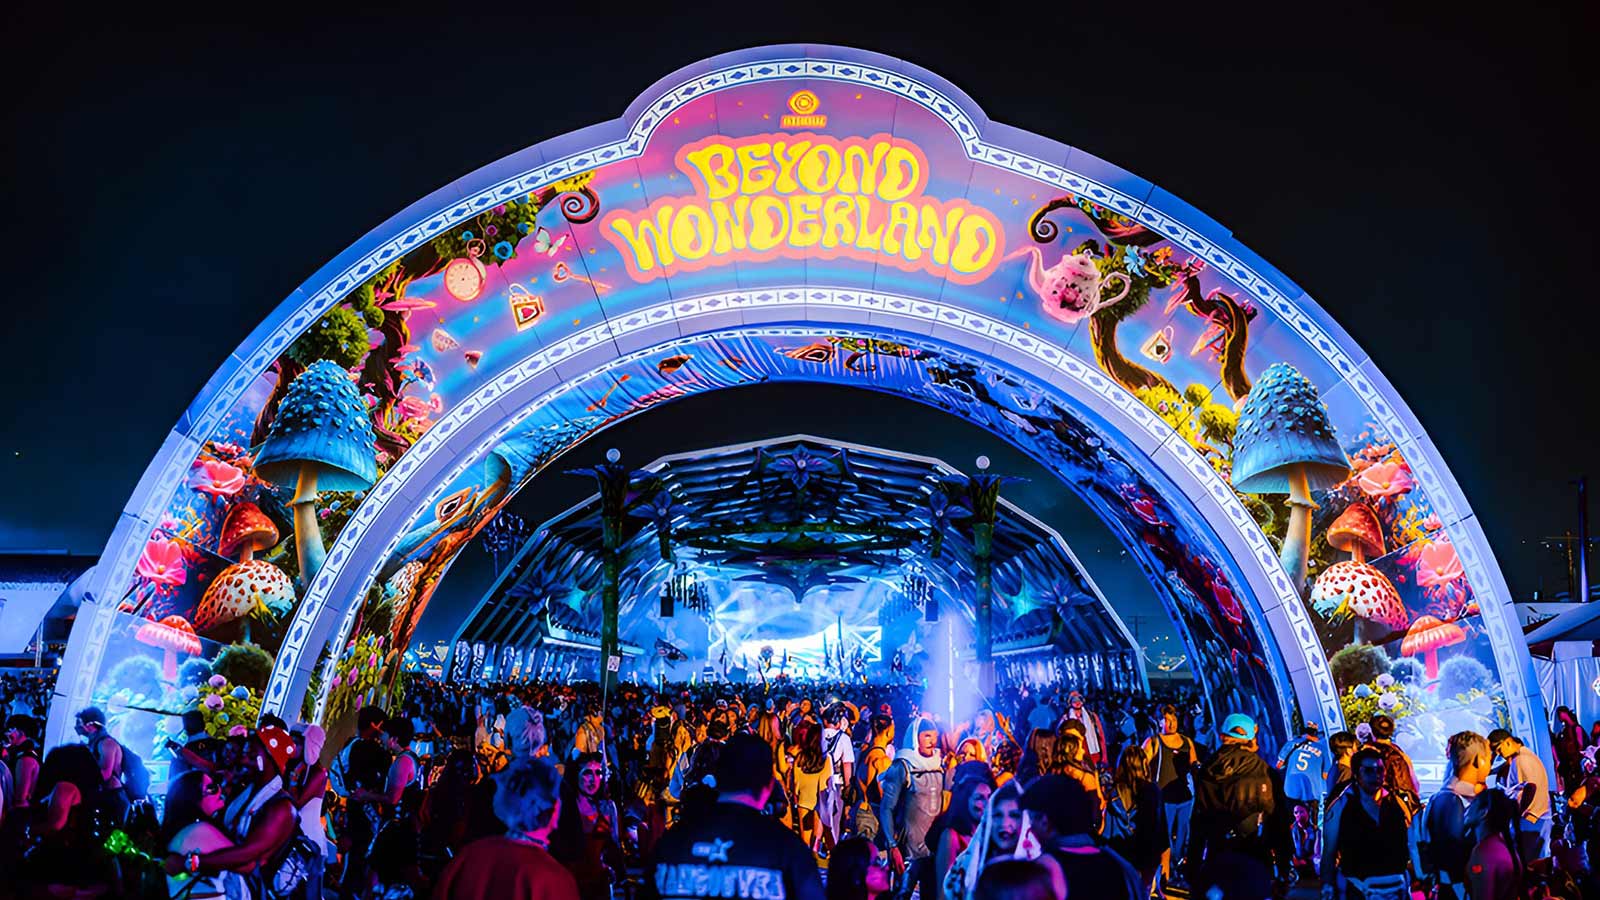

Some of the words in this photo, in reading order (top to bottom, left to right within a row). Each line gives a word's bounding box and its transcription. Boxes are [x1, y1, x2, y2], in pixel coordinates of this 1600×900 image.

[686, 140, 921, 202] BEYOND
[611, 194, 998, 274] WONDERLAND
[1295, 752, 1311, 771] 5
